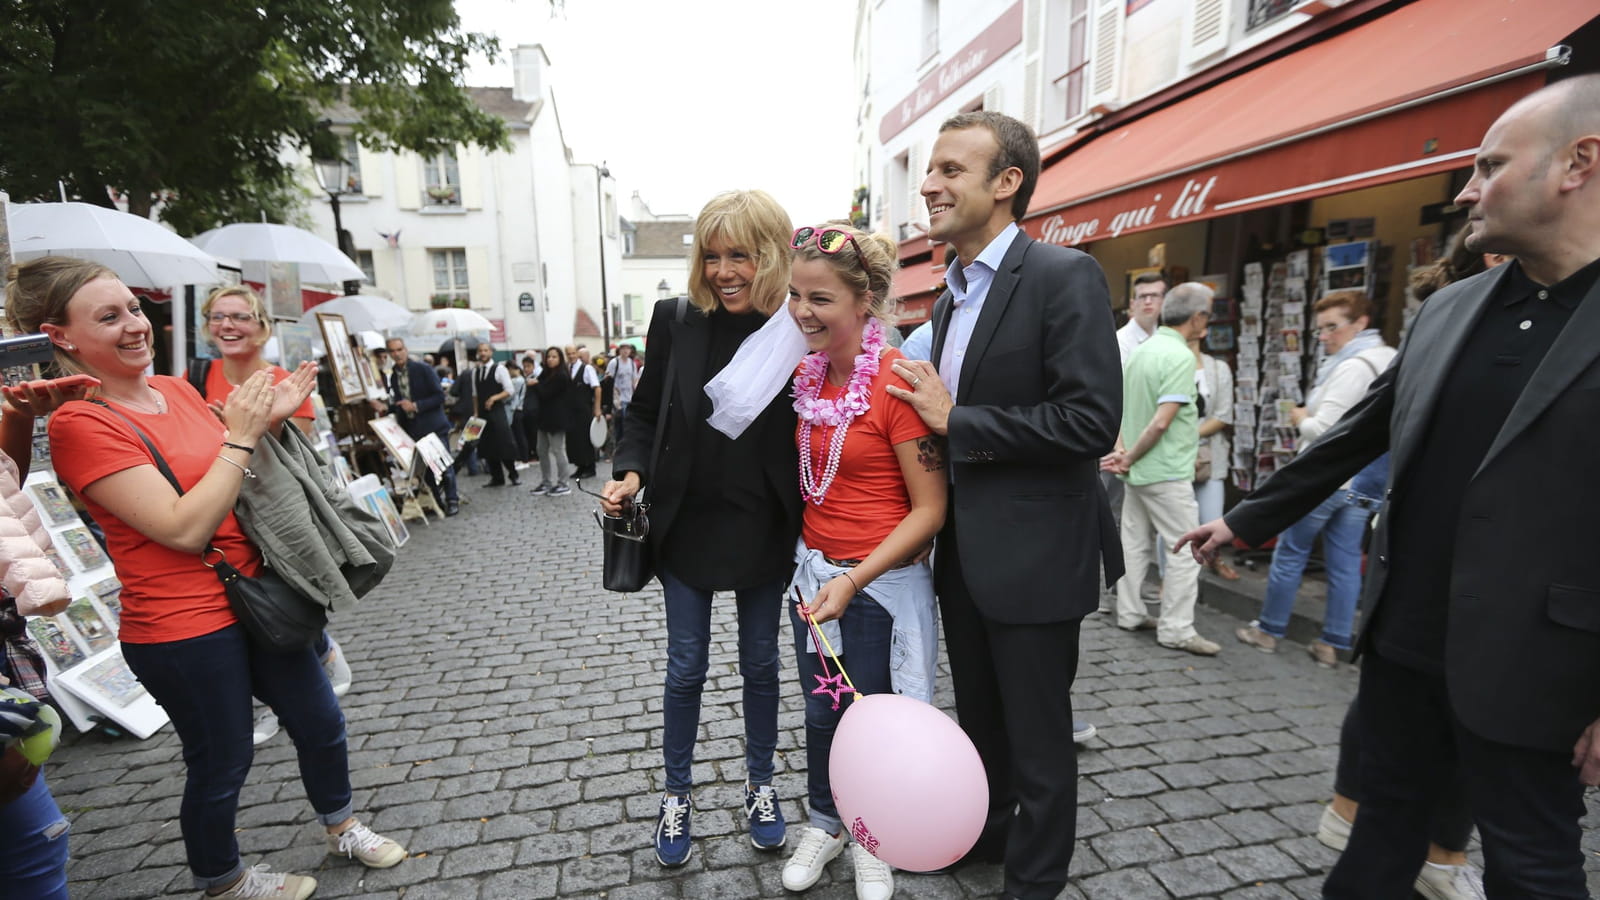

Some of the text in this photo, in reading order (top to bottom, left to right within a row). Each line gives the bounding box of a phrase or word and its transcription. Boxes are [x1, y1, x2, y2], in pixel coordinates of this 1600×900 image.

[1037, 175, 1218, 246] Singe qui lit
